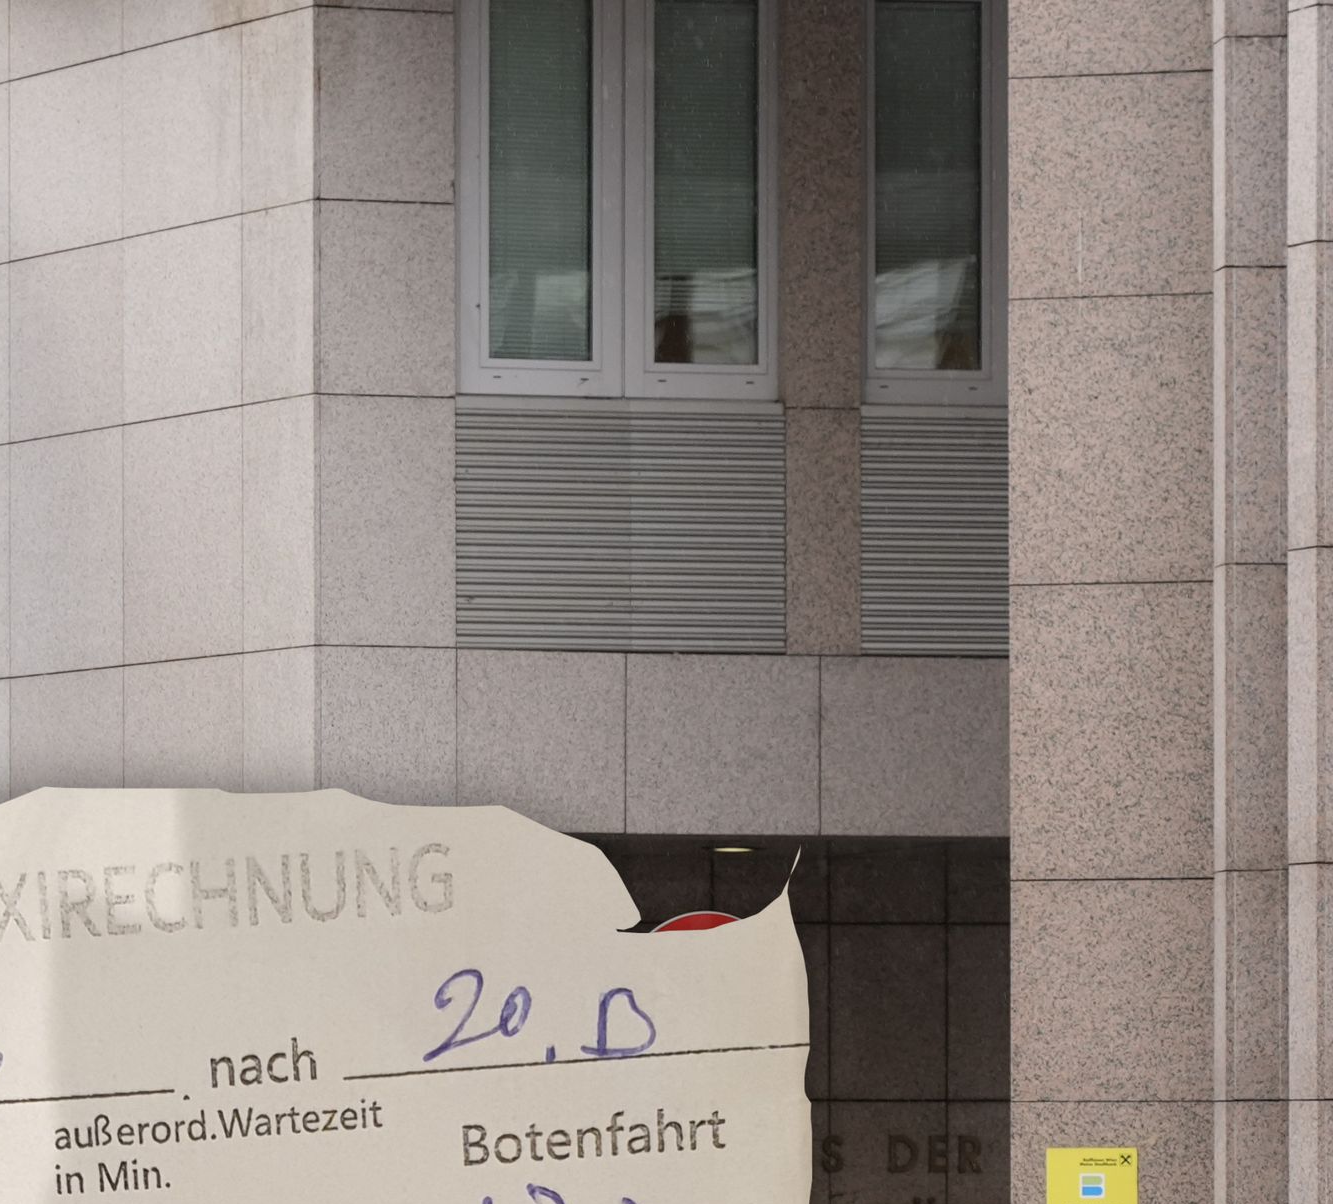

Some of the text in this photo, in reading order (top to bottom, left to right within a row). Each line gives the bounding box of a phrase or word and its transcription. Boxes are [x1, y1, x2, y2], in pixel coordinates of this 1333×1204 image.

[209, 1036, 318, 1089] nach
[461, 1107, 727, 1167] Botenfahrt
[888, 1134, 982, 1174] DER
[54, 1158, 171, 1196] in Min.
